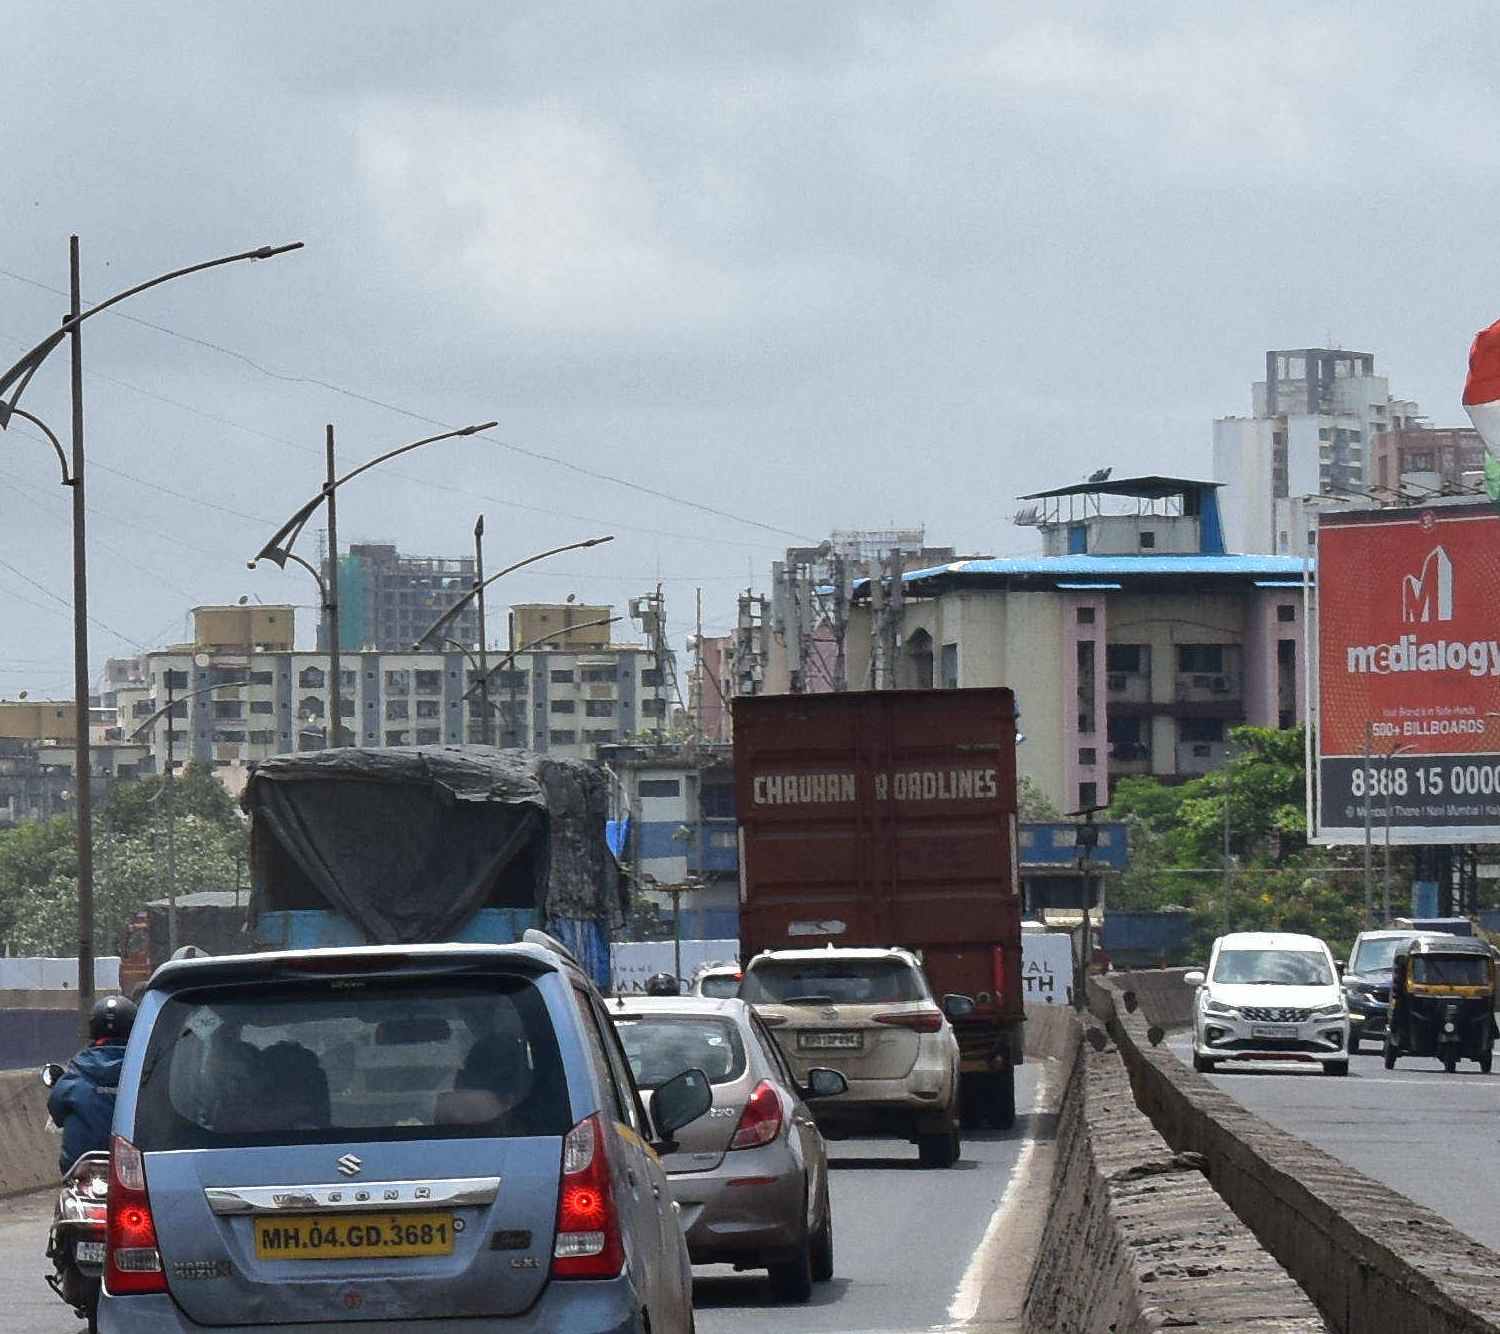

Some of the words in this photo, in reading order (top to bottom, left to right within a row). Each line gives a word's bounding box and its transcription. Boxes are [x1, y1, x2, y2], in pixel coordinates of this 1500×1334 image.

[1372, 722, 1400, 737] 500+
[1403, 719, 1485, 736] BILLBOARDS
[753, 774, 856, 805] CHAUHAN
[1415, 767, 1444, 796] 15
[261, 1222, 447, 1250] MH.04.GD.3681
